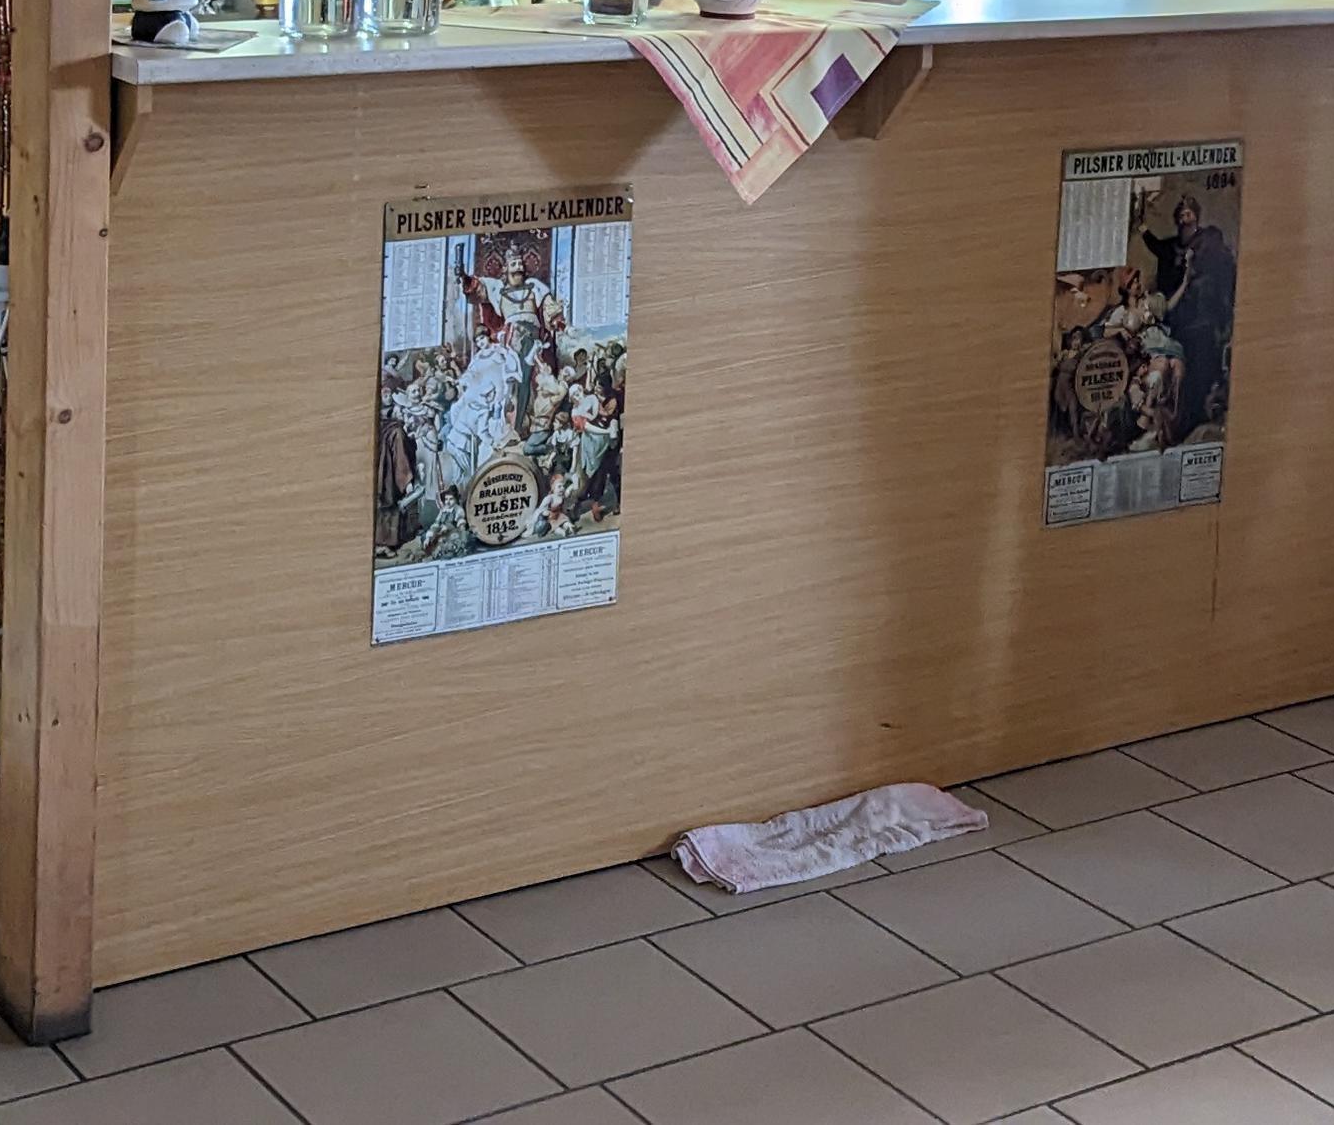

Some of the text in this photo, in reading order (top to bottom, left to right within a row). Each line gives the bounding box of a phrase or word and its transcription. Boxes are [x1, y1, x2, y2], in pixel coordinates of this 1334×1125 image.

[1074, 155, 1124, 175] PILSNER
[397, 209, 465, 234] PILSNER
[479, 483, 528, 499] BRAUHAUS
[474, 495, 532, 516] PILSEN
